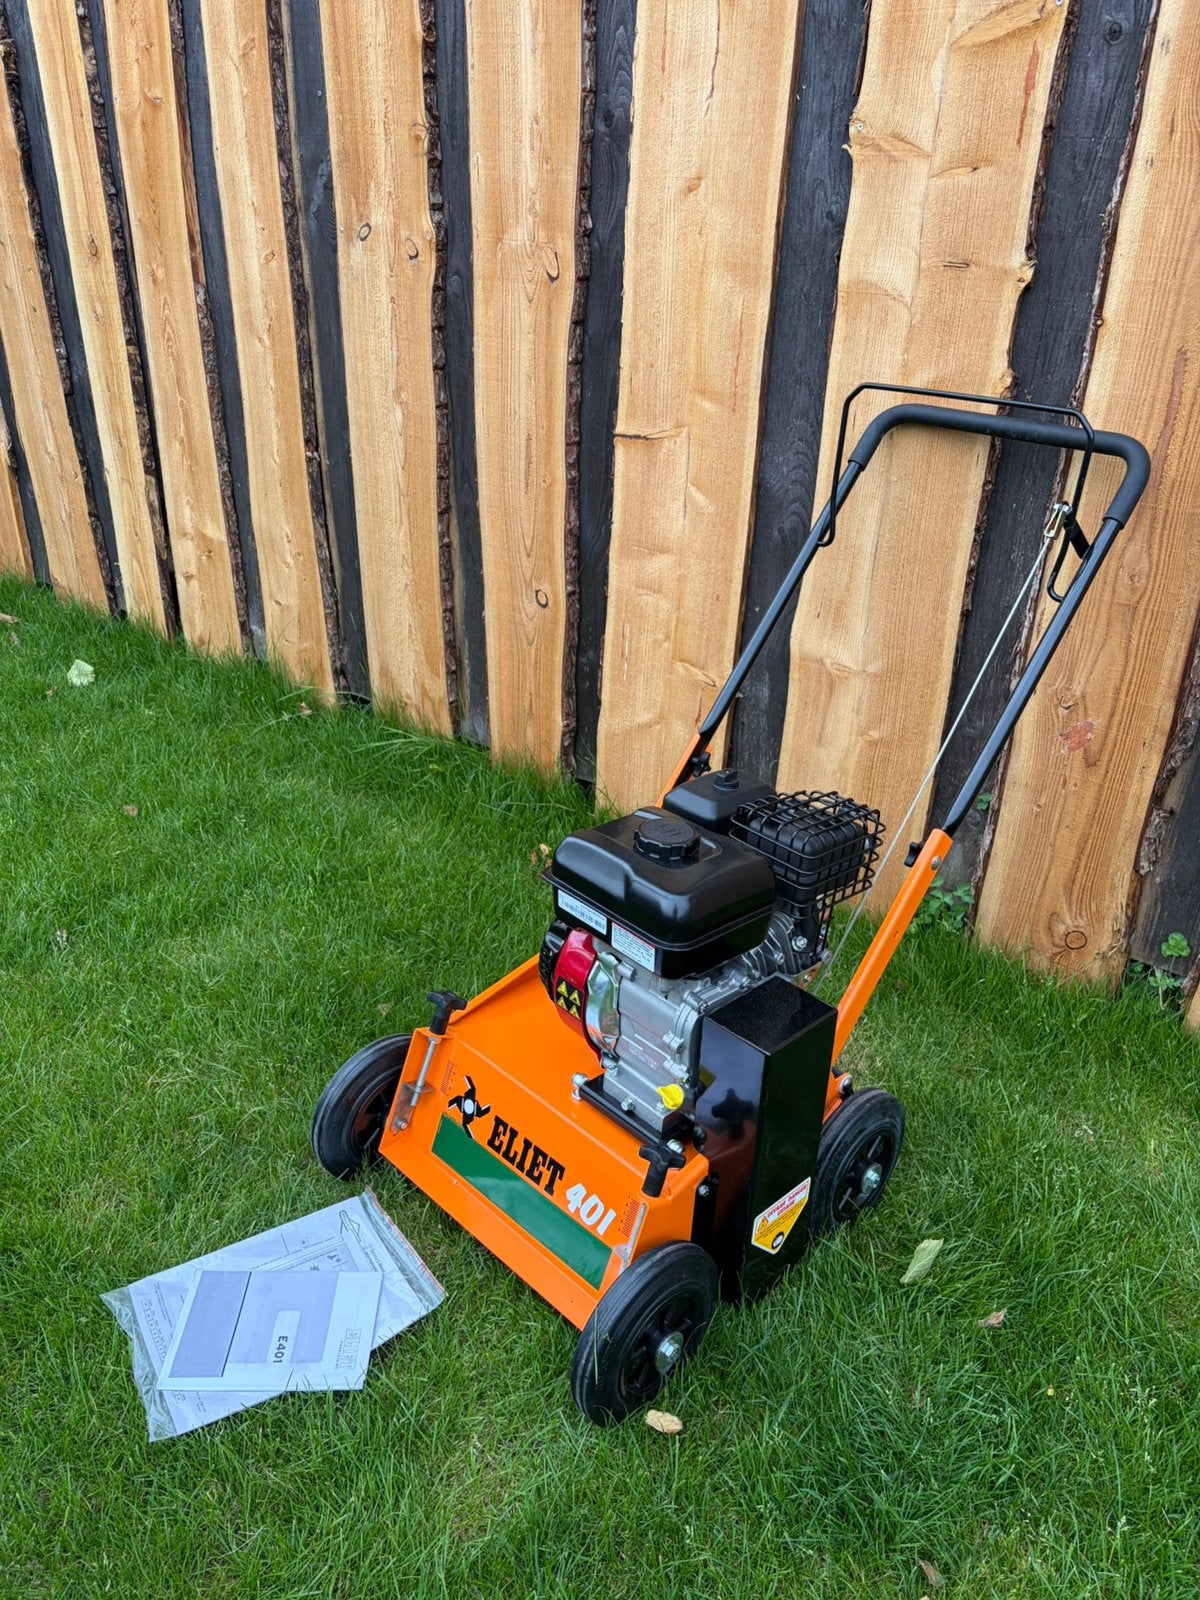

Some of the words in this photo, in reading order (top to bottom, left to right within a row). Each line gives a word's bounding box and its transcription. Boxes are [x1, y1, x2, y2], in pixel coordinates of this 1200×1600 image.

[486, 1115, 566, 1197] ELIET
[565, 1182, 617, 1236] 401
[273, 1335, 289, 1364] E401
